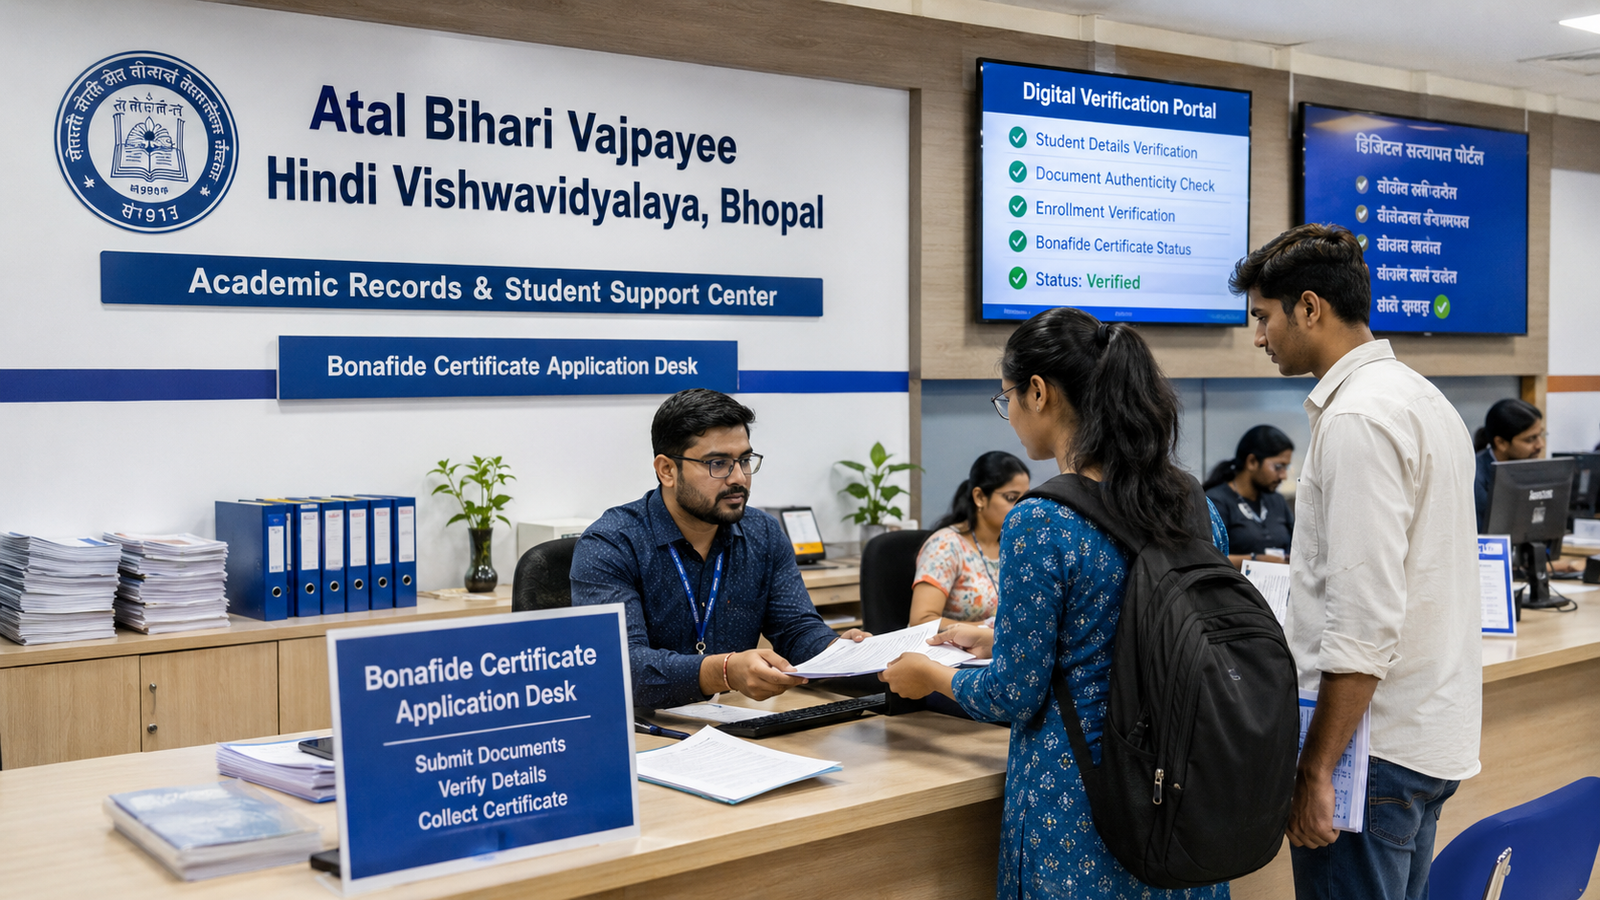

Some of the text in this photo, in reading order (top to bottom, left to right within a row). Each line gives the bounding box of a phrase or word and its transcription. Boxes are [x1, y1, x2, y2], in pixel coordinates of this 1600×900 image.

[1024, 82, 1216, 119] Digital Verification Portal
[309, 85, 736, 170] Atal Bihari Vajpayee
[1036, 132, 1197, 159] Student Details Verification
[268, 156, 823, 236] Hindi Vishwavidyalaya, Bhopal
[1037, 166, 1215, 192] Document Authenticity Check
[1037, 201, 1175, 222] Enrollment Verification
[1037, 235, 1191, 255] Bonafide Certificate Status
[189, 268, 777, 309] Academic Records & Student Support Center
[1036, 272, 1140, 289] Status: Verified
[328, 356, 698, 379] Bonafide Certificate Application Desk
[365, 645, 596, 690] Bonafide Certificate
[396, 680, 577, 726] Application Desk
[416, 738, 566, 773] Submit Documents
[438, 766, 546, 797] Verify Details
[419, 792, 567, 830] Collect Certificate
